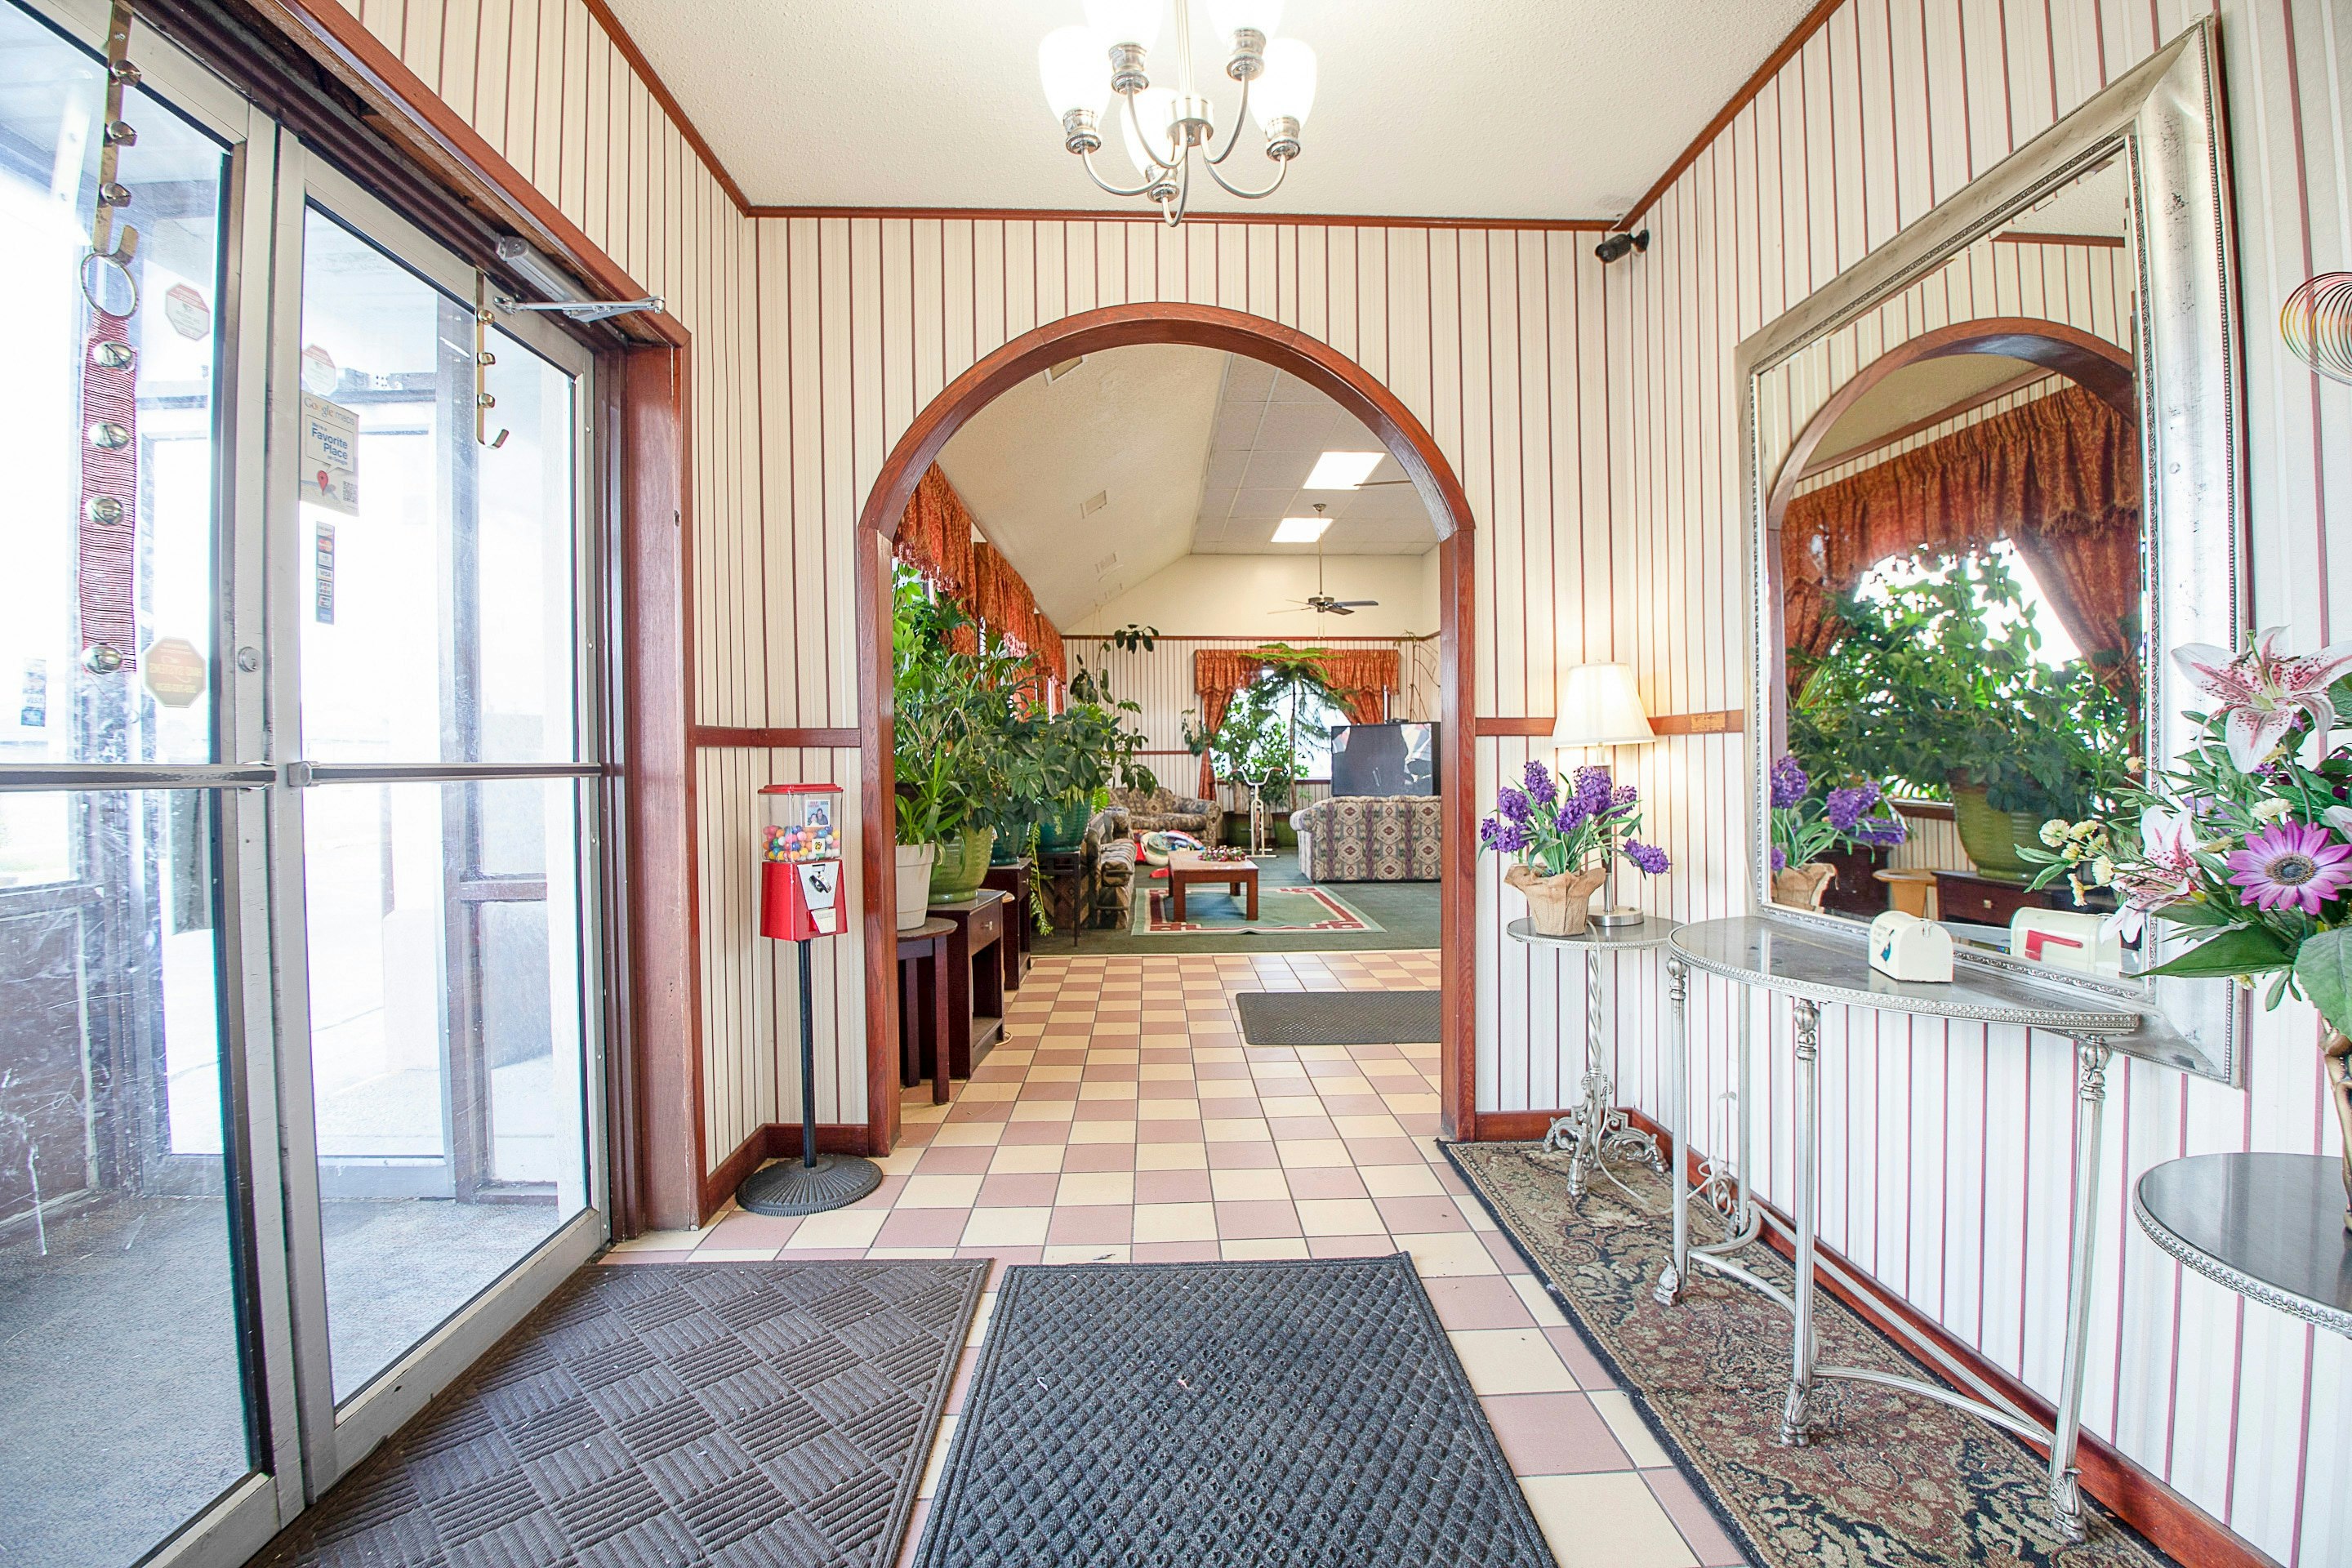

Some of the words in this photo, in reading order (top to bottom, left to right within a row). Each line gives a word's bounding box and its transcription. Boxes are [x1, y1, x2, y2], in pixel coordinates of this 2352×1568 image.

[304, 397, 334, 418] Google
[335, 412, 354, 425] maps
[311, 426, 348, 449] Favorite
[323, 442, 347, 460] Place
